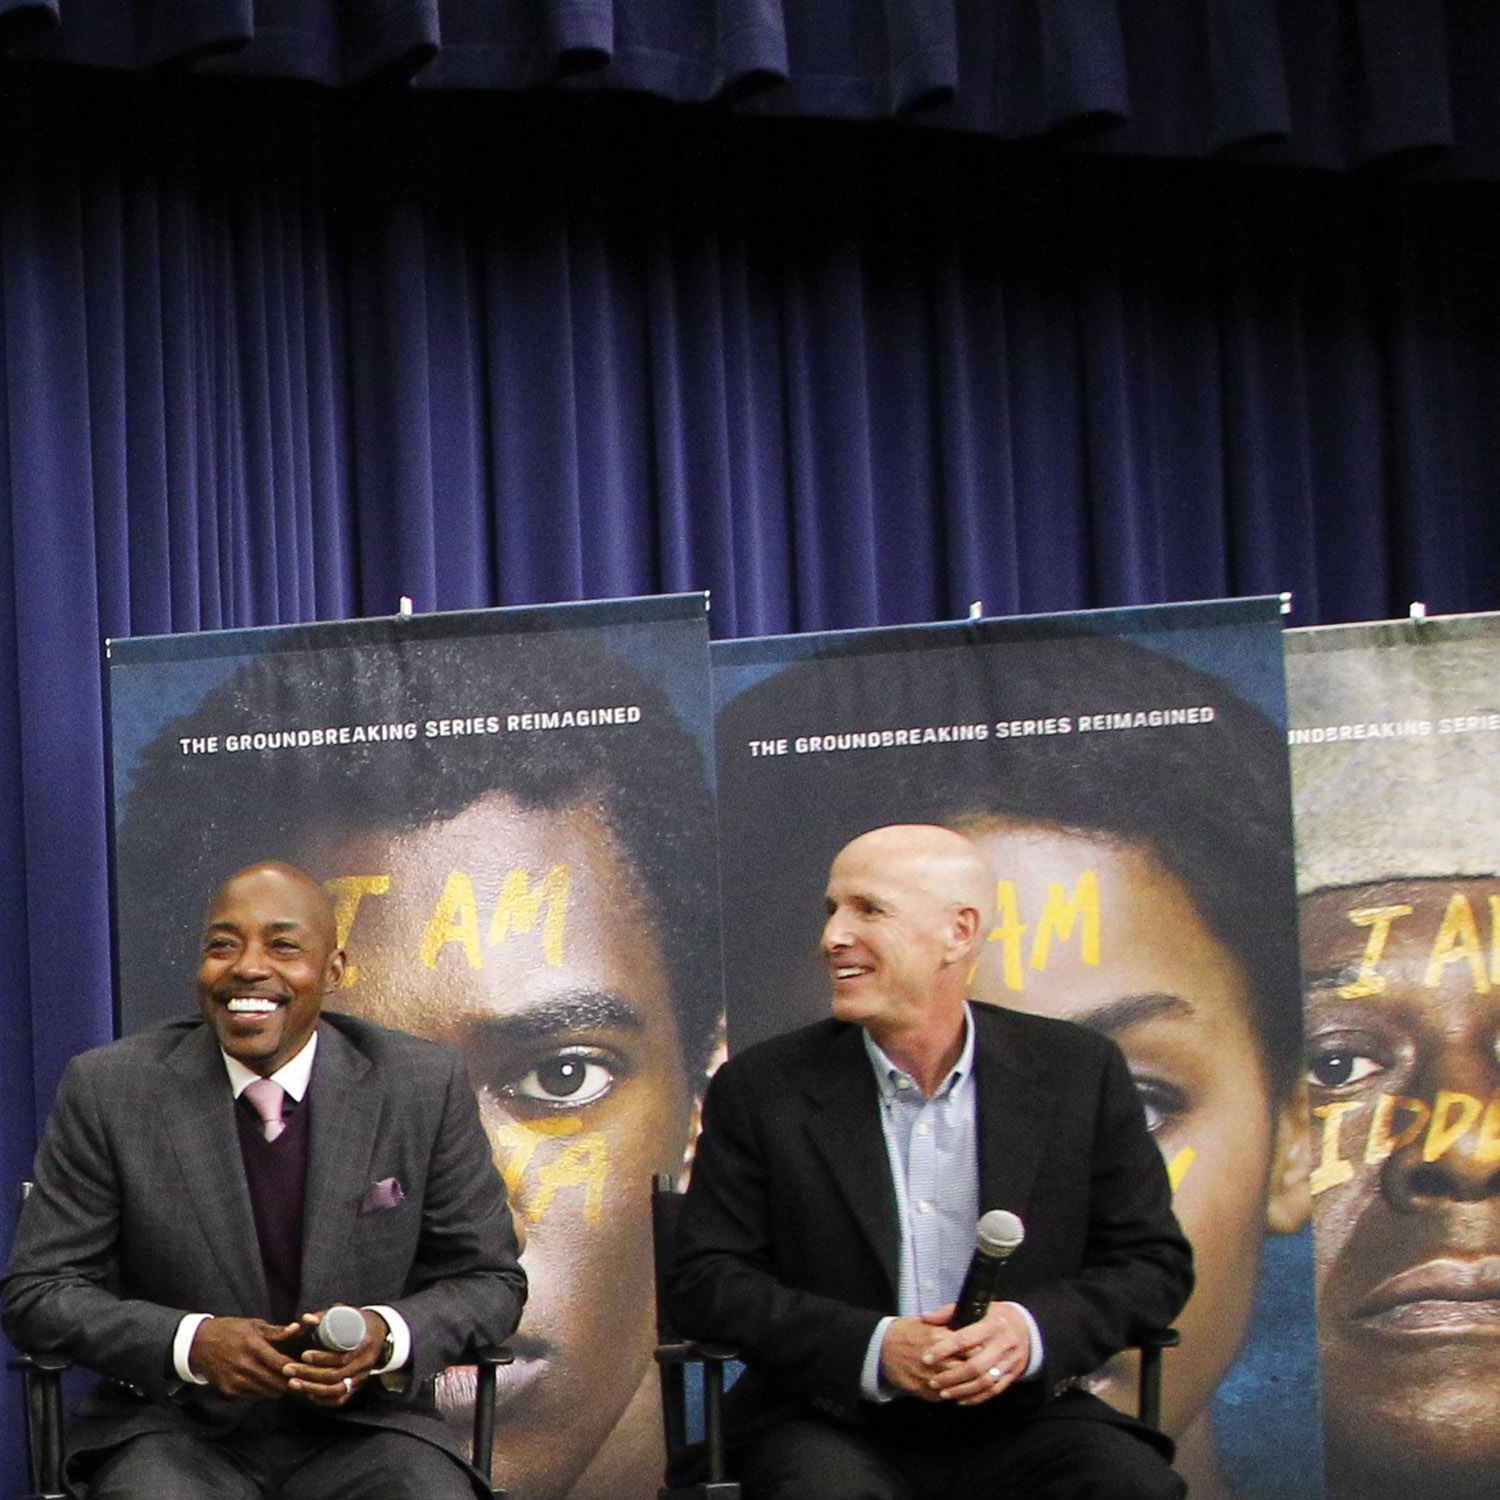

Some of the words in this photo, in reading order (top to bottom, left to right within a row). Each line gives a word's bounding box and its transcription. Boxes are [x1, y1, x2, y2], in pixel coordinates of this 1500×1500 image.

[179, 736, 219, 756] THE
[225, 722, 418, 753] GROUNDBREAKING
[425, 716, 500, 739] SERIES
[506, 706, 641, 732] REIMAGINED
[749, 739, 789, 757] THE
[794, 723, 989, 755] GROUNDBREAKING
[995, 716, 1072, 739] SERIES
[1078, 706, 1215, 732] REIMAGINED
[419, 862, 573, 970] AM
[1338, 903, 1413, 999] I
[1423, 893, 1500, 995] A
